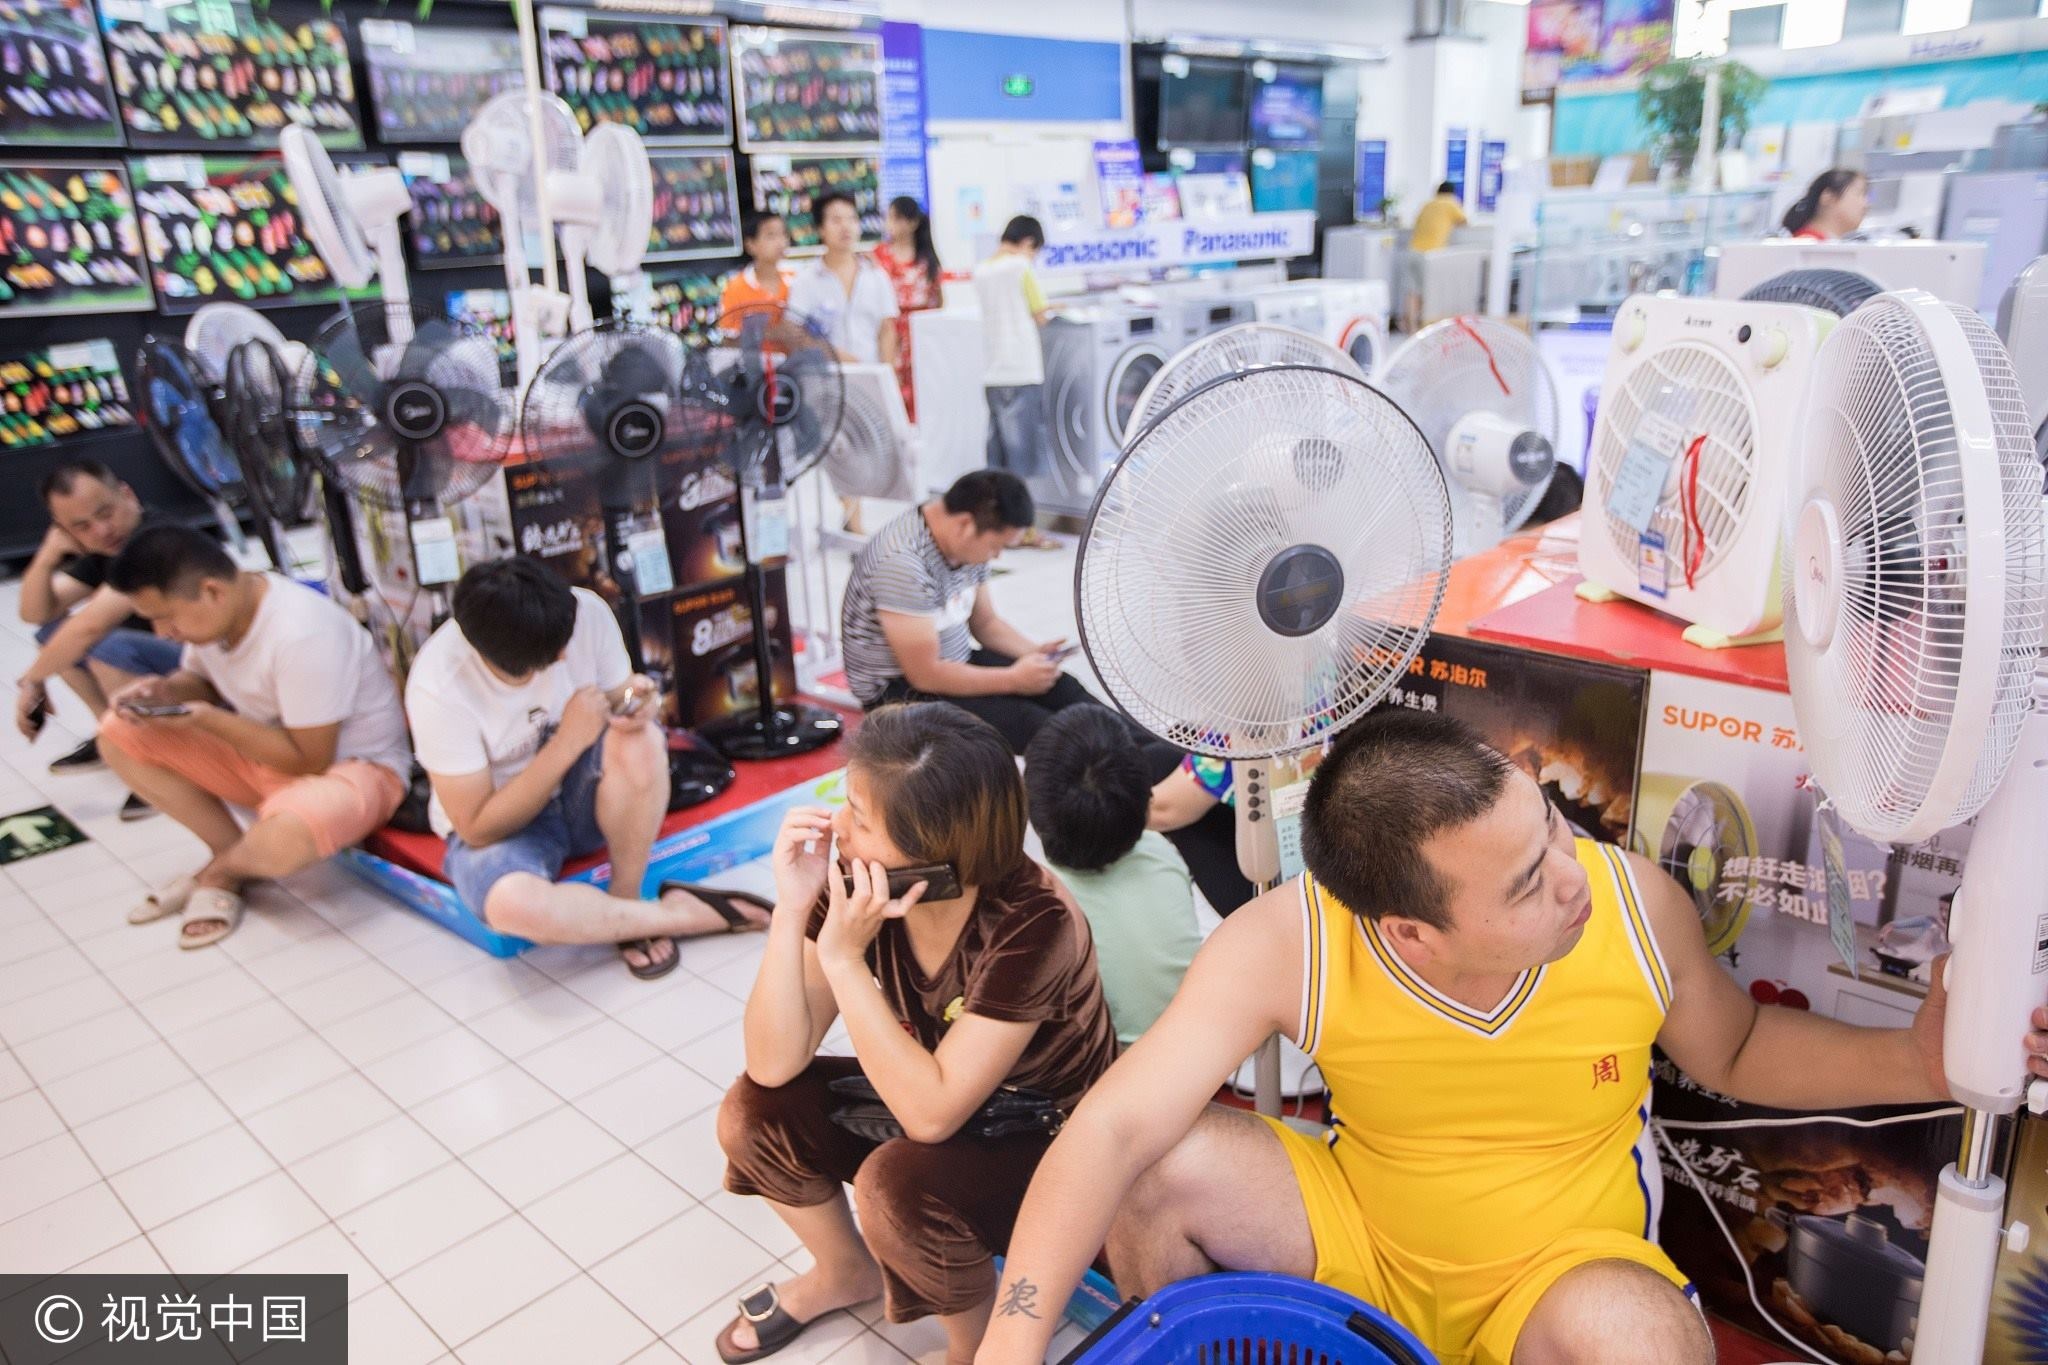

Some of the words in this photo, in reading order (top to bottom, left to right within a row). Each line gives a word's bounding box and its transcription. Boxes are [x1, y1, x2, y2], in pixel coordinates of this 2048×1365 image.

[1184, 228, 1289, 249] Panasonic
[691, 618, 713, 656] 8
[1429, 660, 1488, 689] 苏泊尔
[1662, 704, 1763, 743] SUPOR
[1592, 1054, 1620, 1090] 周
